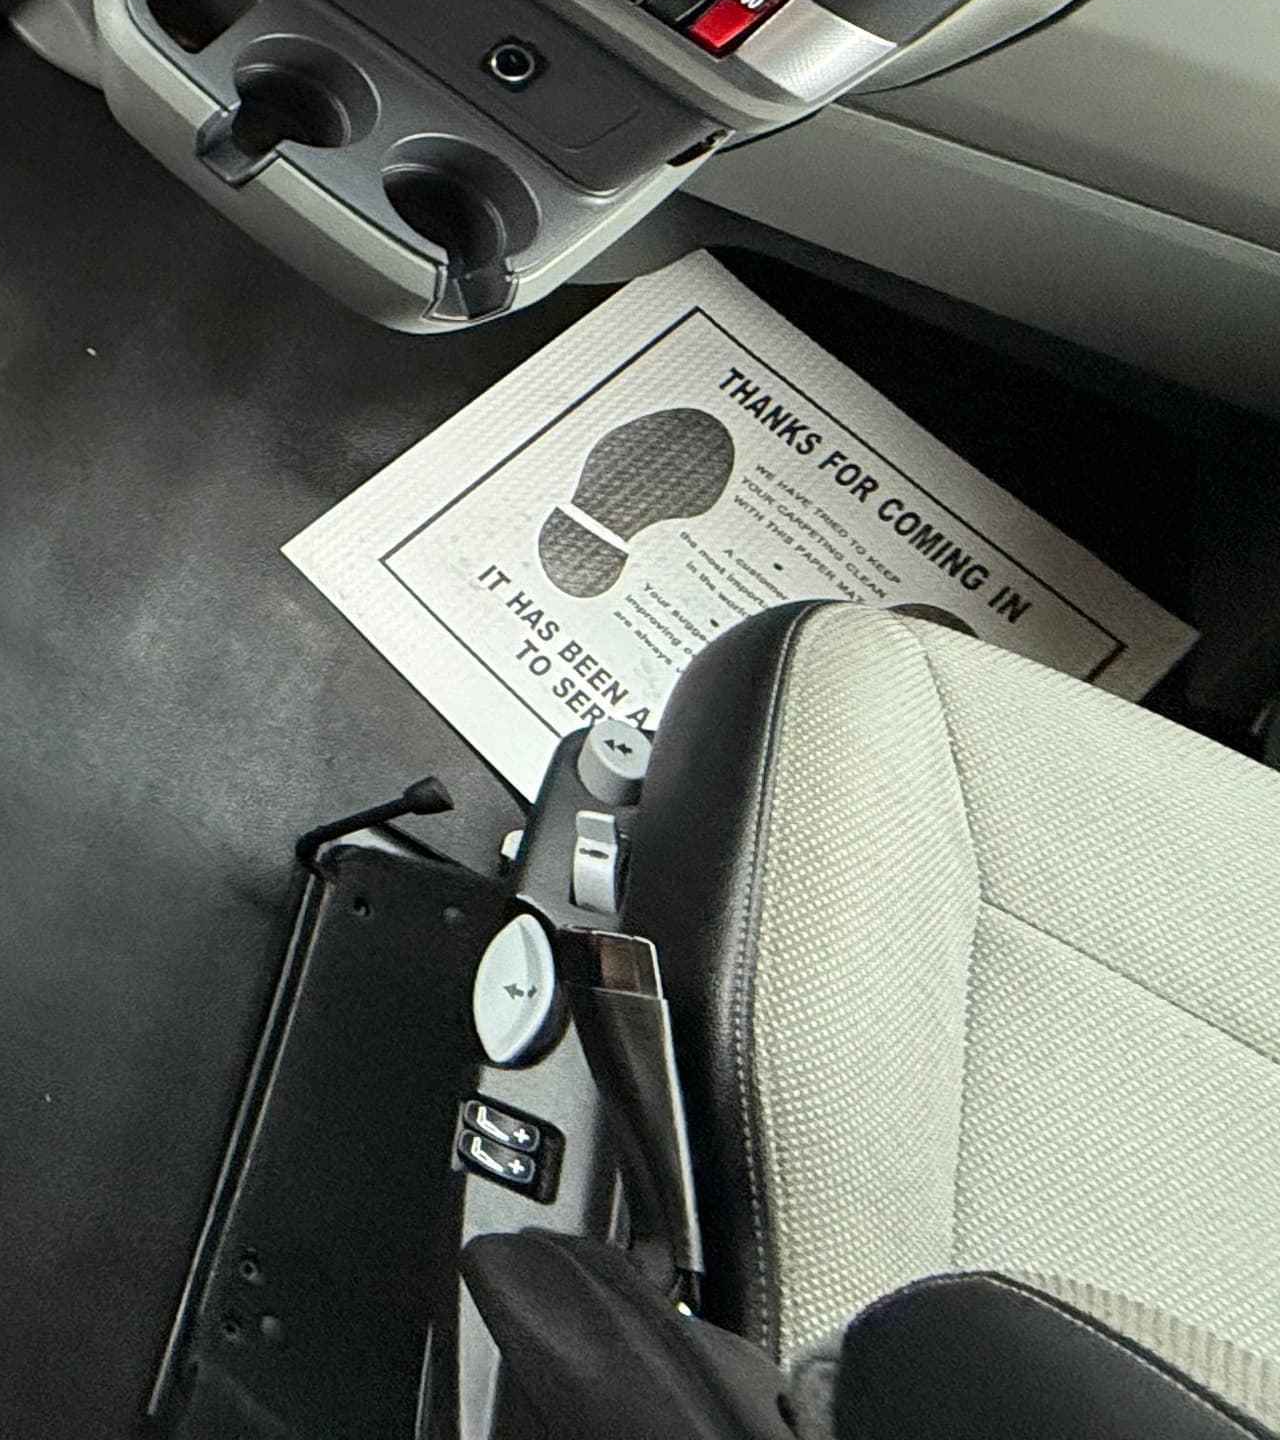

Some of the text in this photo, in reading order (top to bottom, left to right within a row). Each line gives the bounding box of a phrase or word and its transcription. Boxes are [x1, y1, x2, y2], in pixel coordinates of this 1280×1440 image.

[718, 367, 1033, 624] THANKS FOR COMING IN
[733, 495, 765, 522] WITH
[765, 520, 795, 545] THIS
[794, 544, 837, 582] PAPER
[741, 476, 887, 599] YOUR CARPETING CLEAN
[755, 464, 901, 584] WE HAVE TRIED TO KEEP
[680, 531, 697, 549] the
[698, 549, 726, 575] most
[686, 560, 697, 574] in
[699, 573, 716, 592] the
[477, 564, 511, 592] IT
[505, 590, 560, 642] HAS
[557, 639, 630, 707] BEEN
[613, 610, 672, 665] are always
[625, 594, 682, 647] improving
[643, 582, 710, 644] Your sugge
[515, 639, 614, 728] TO SER
